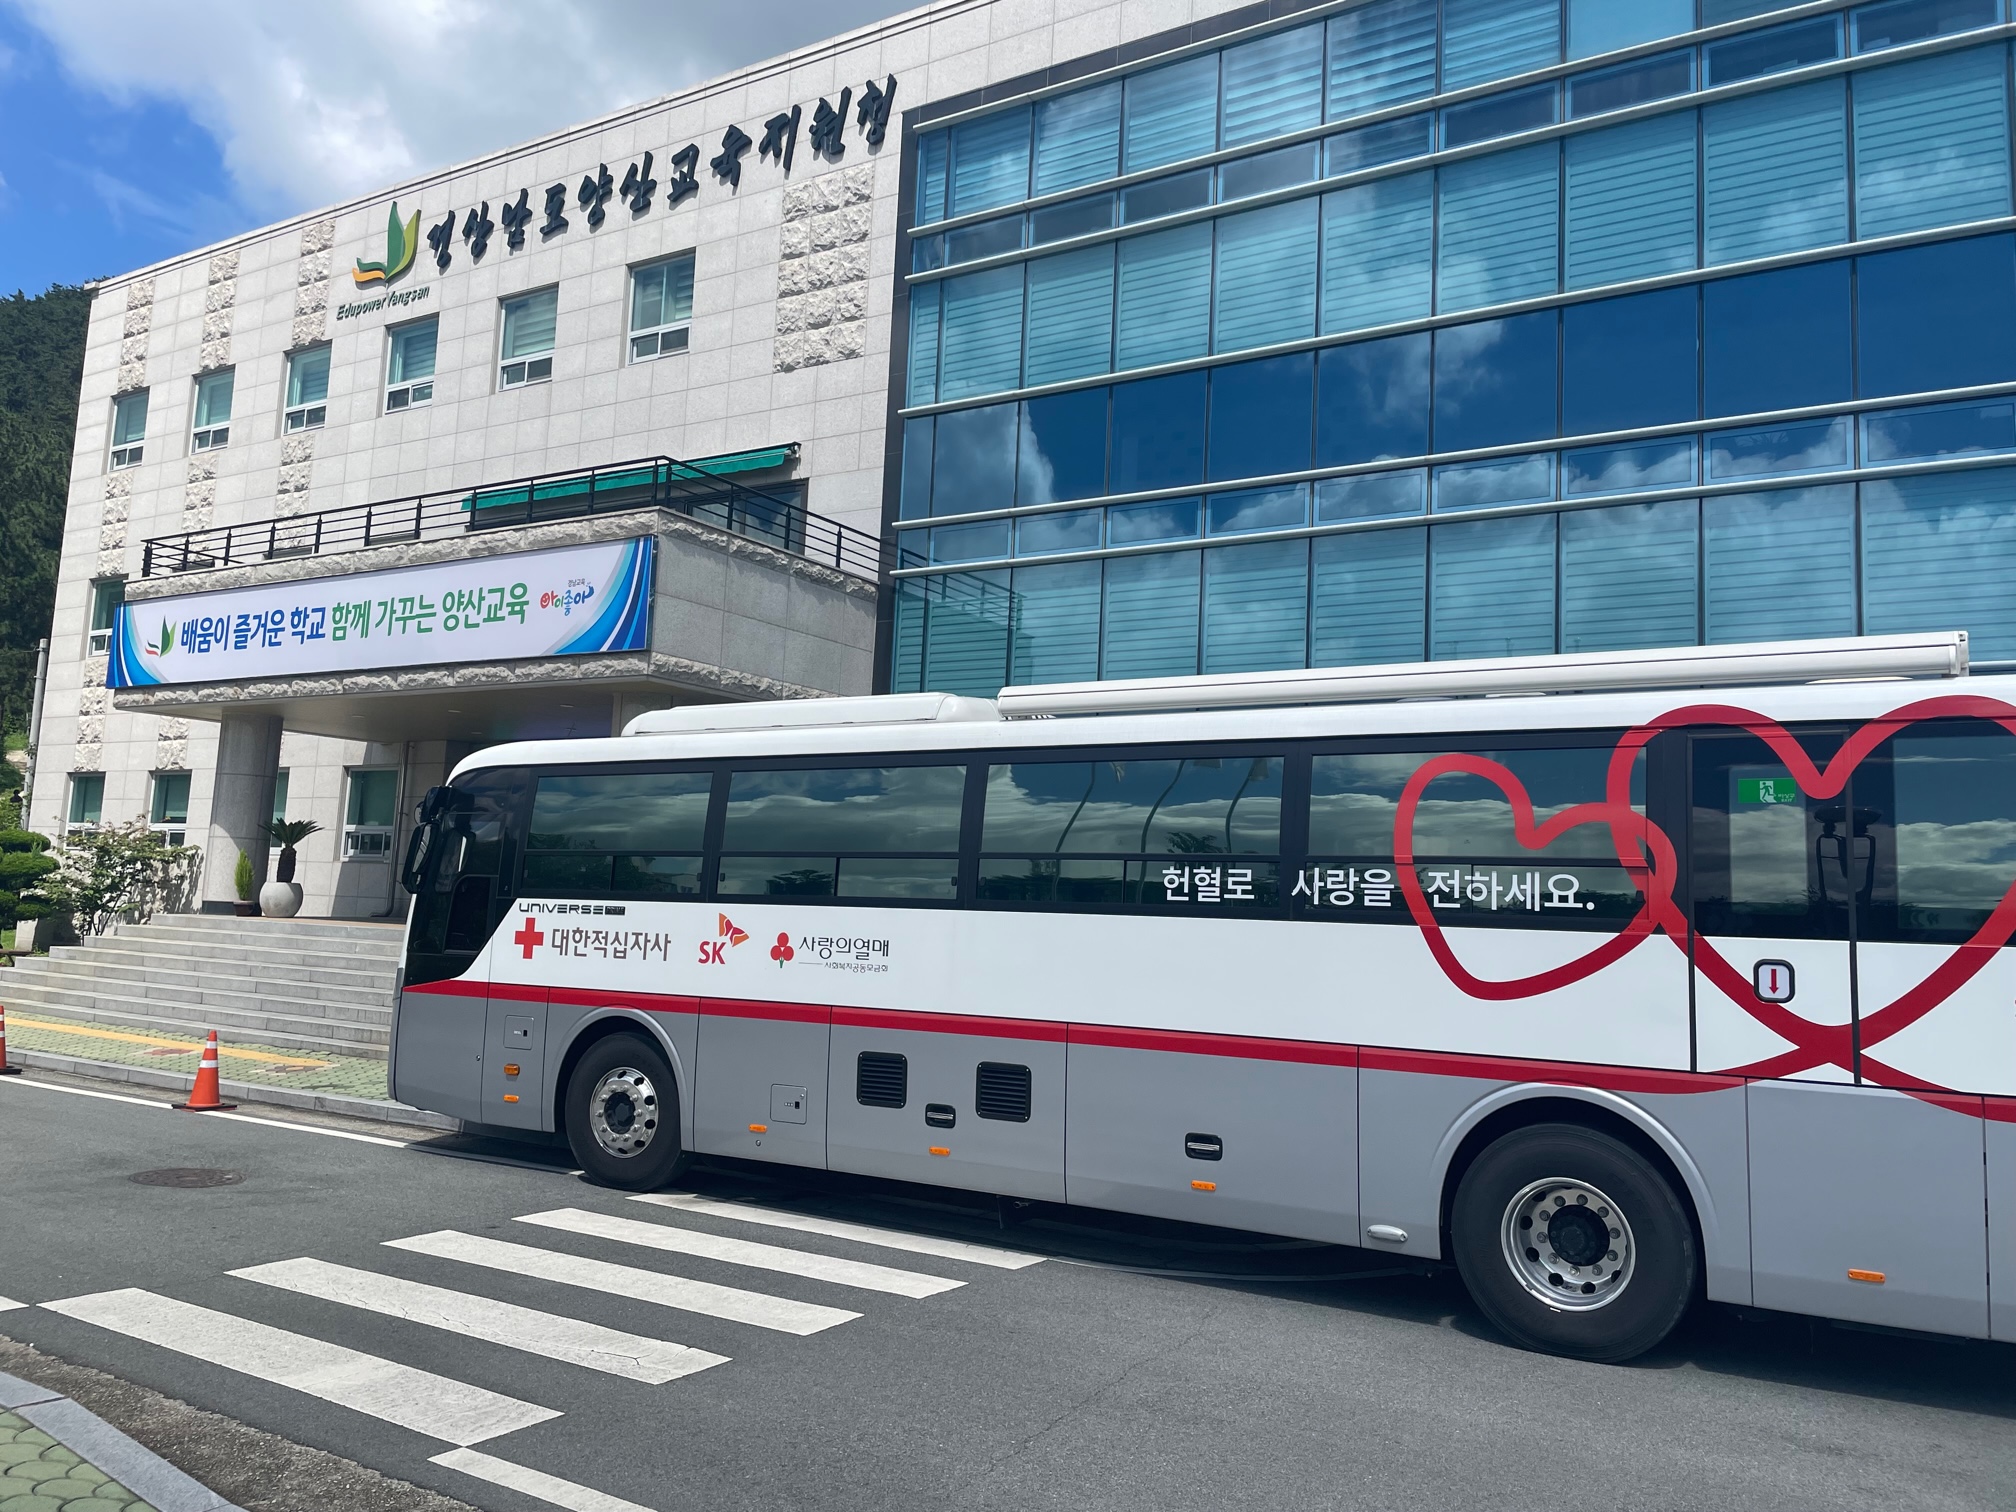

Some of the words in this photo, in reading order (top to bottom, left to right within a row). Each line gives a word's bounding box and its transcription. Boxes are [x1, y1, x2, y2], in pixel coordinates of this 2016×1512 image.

[336, 295, 388, 321] Edupower
[180, 614, 231, 654] 배움이
[233, 609, 286, 650] 즐거운
[290, 606, 327, 645] 학교
[331, 599, 372, 642] 함께
[374, 594, 437, 637] 가꾸는
[442, 582, 530, 632] 양산교육
[1161, 866, 1256, 903] 헌혈로
[1291, 867, 1396, 907] 사랑을
[1426, 869, 1597, 912] 전하세요.
[518, 902, 604, 915] UNIVERSE
[551, 926, 672, 962] 대한적십자사
[697, 940, 727, 965] SK
[798, 936, 890, 961] 사랑의열매
